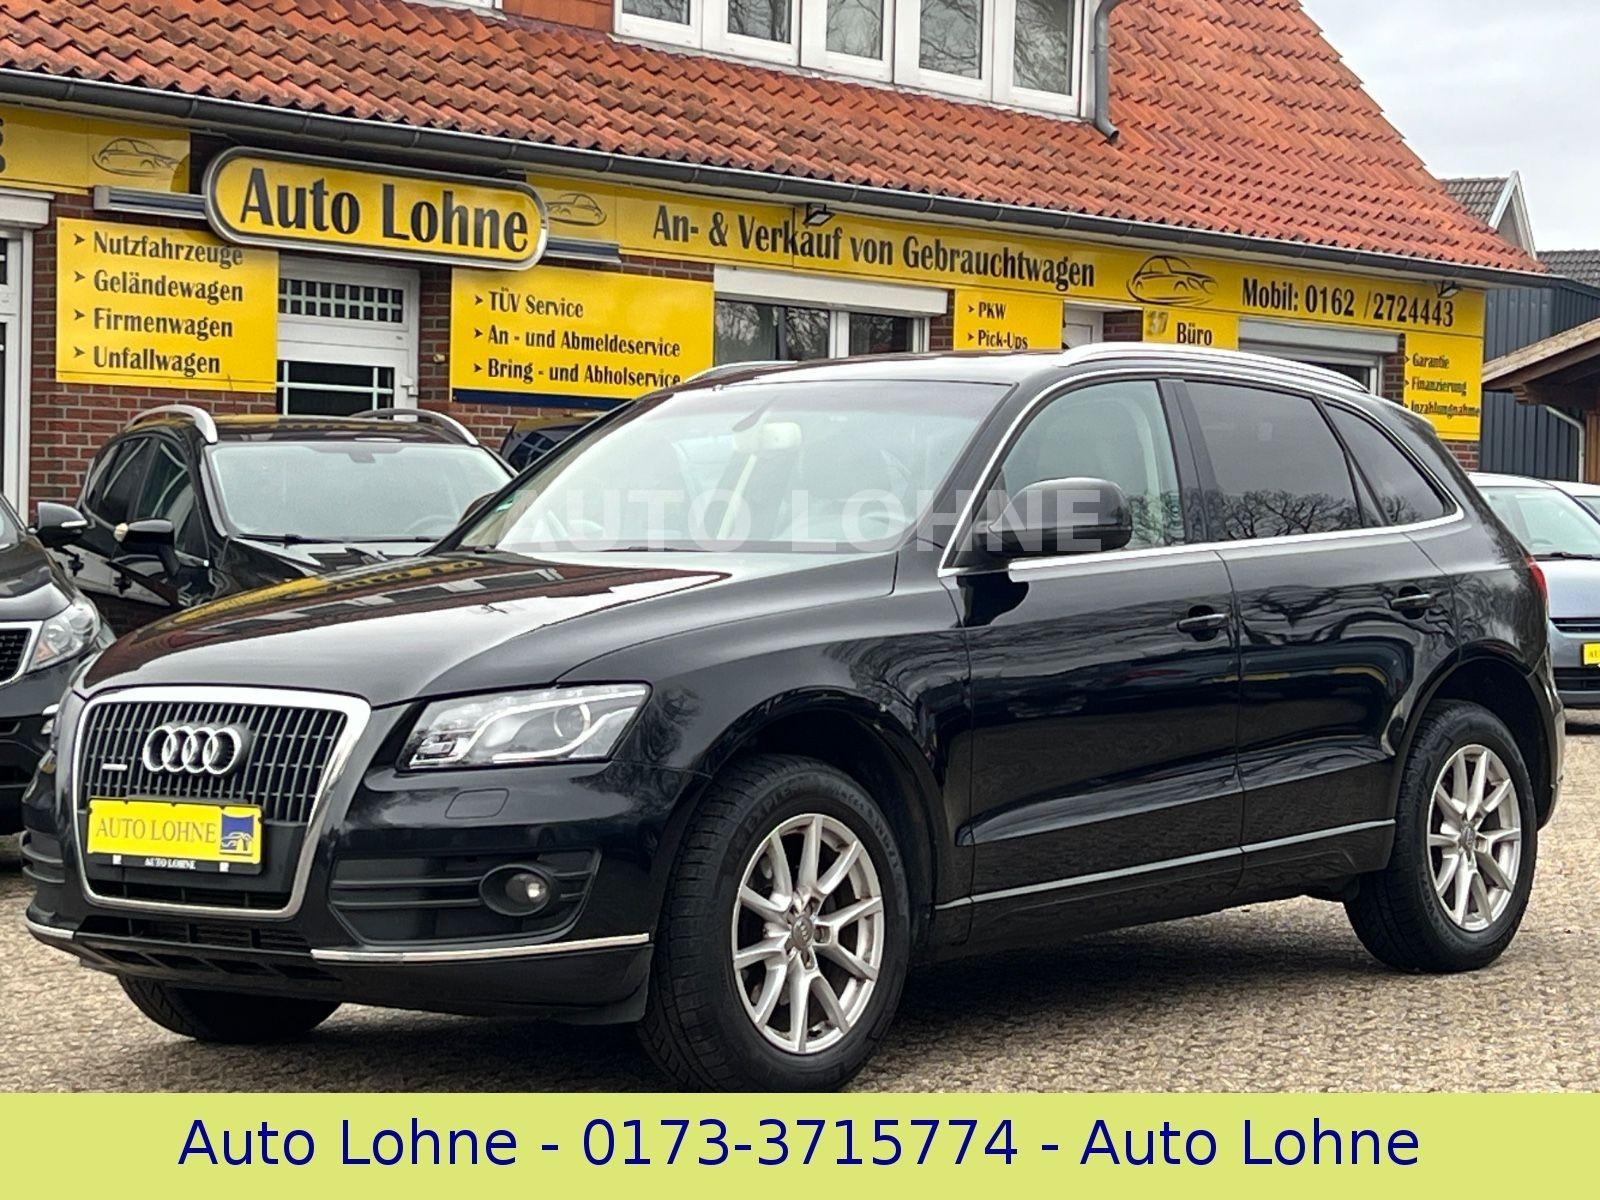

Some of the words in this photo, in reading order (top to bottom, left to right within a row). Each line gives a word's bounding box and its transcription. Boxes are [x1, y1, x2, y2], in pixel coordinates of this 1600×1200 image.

[240, 167, 360, 234] Auto
[382, 183, 529, 253] Lohne
[94, 230, 243, 269] Nutzfahrzeuge
[653, 205, 699, 242] An-
[708, 211, 728, 247] &
[738, 214, 842, 260] Verkauf
[850, 236, 893, 265] von
[903, 236, 1094, 291] Gebrauchtwagen
[94, 270, 243, 305] Geländewagen
[489, 287, 521, 312] TÜV
[526, 294, 583, 318] Service
[1242, 278, 1298, 312] Mobil:
[1305, 284, 1354, 317] 0162
[94, 308, 233, 341] Firmenwagen
[979, 302, 1006, 319] PKW
[488, 324, 508, 344] An
[526, 329, 555, 348] und
[561, 330, 680, 357] Abmeldeservice
[978, 329, 1028, 349] Pick-Ups
[1177, 322, 1212, 346] Büro
[94, 346, 220, 377] Unfallwagen
[488, 358, 533, 384] Bring
[549, 364, 578, 382] und
[584, 364, 680, 388] Abholservice
[1413, 352, 1449, 369] Garantie
[1412, 376, 1467, 396] Finanzierung
[96, 817, 146, 839] AUTO
[150, 819, 217, 844] LOHNE
